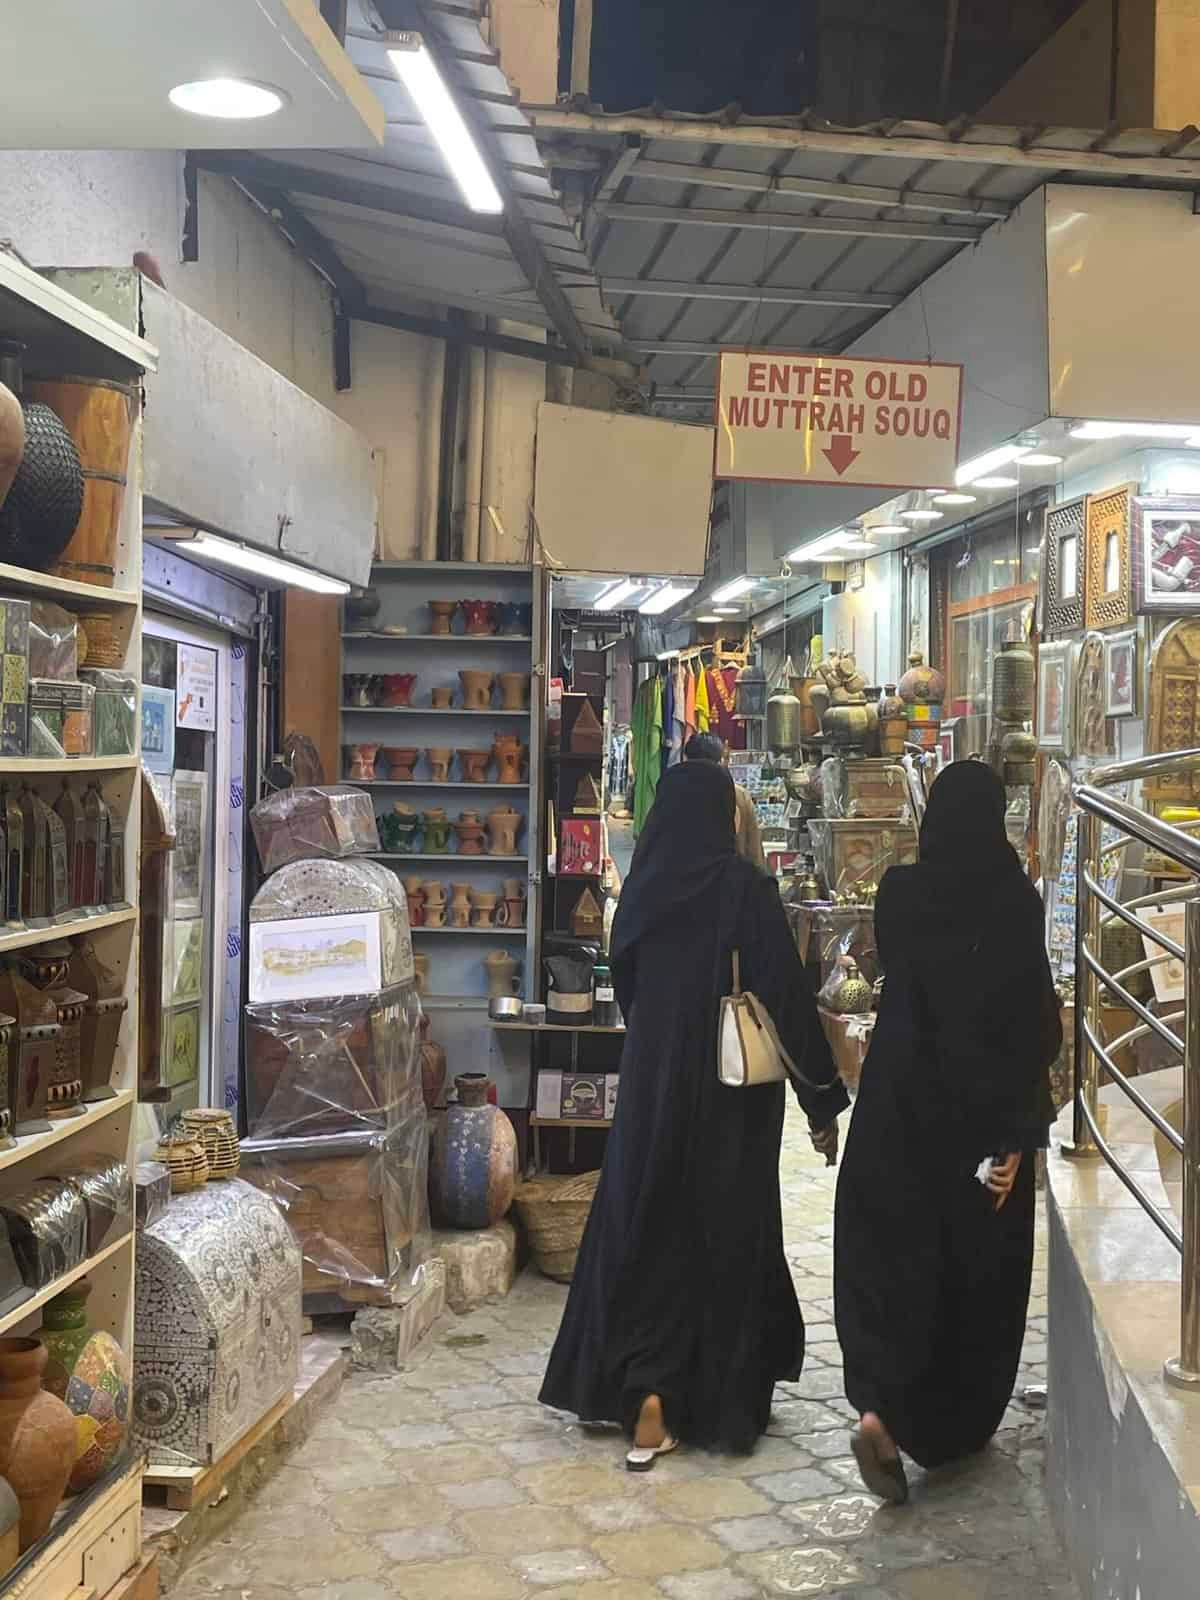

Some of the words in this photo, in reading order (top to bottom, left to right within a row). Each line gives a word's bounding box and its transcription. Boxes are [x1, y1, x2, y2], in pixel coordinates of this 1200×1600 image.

[747, 362, 854, 398] ENTER
[865, 370, 928, 402] OLD
[728, 396, 865, 434] MUTTRAH
[875, 405, 951, 440] SOUQ
